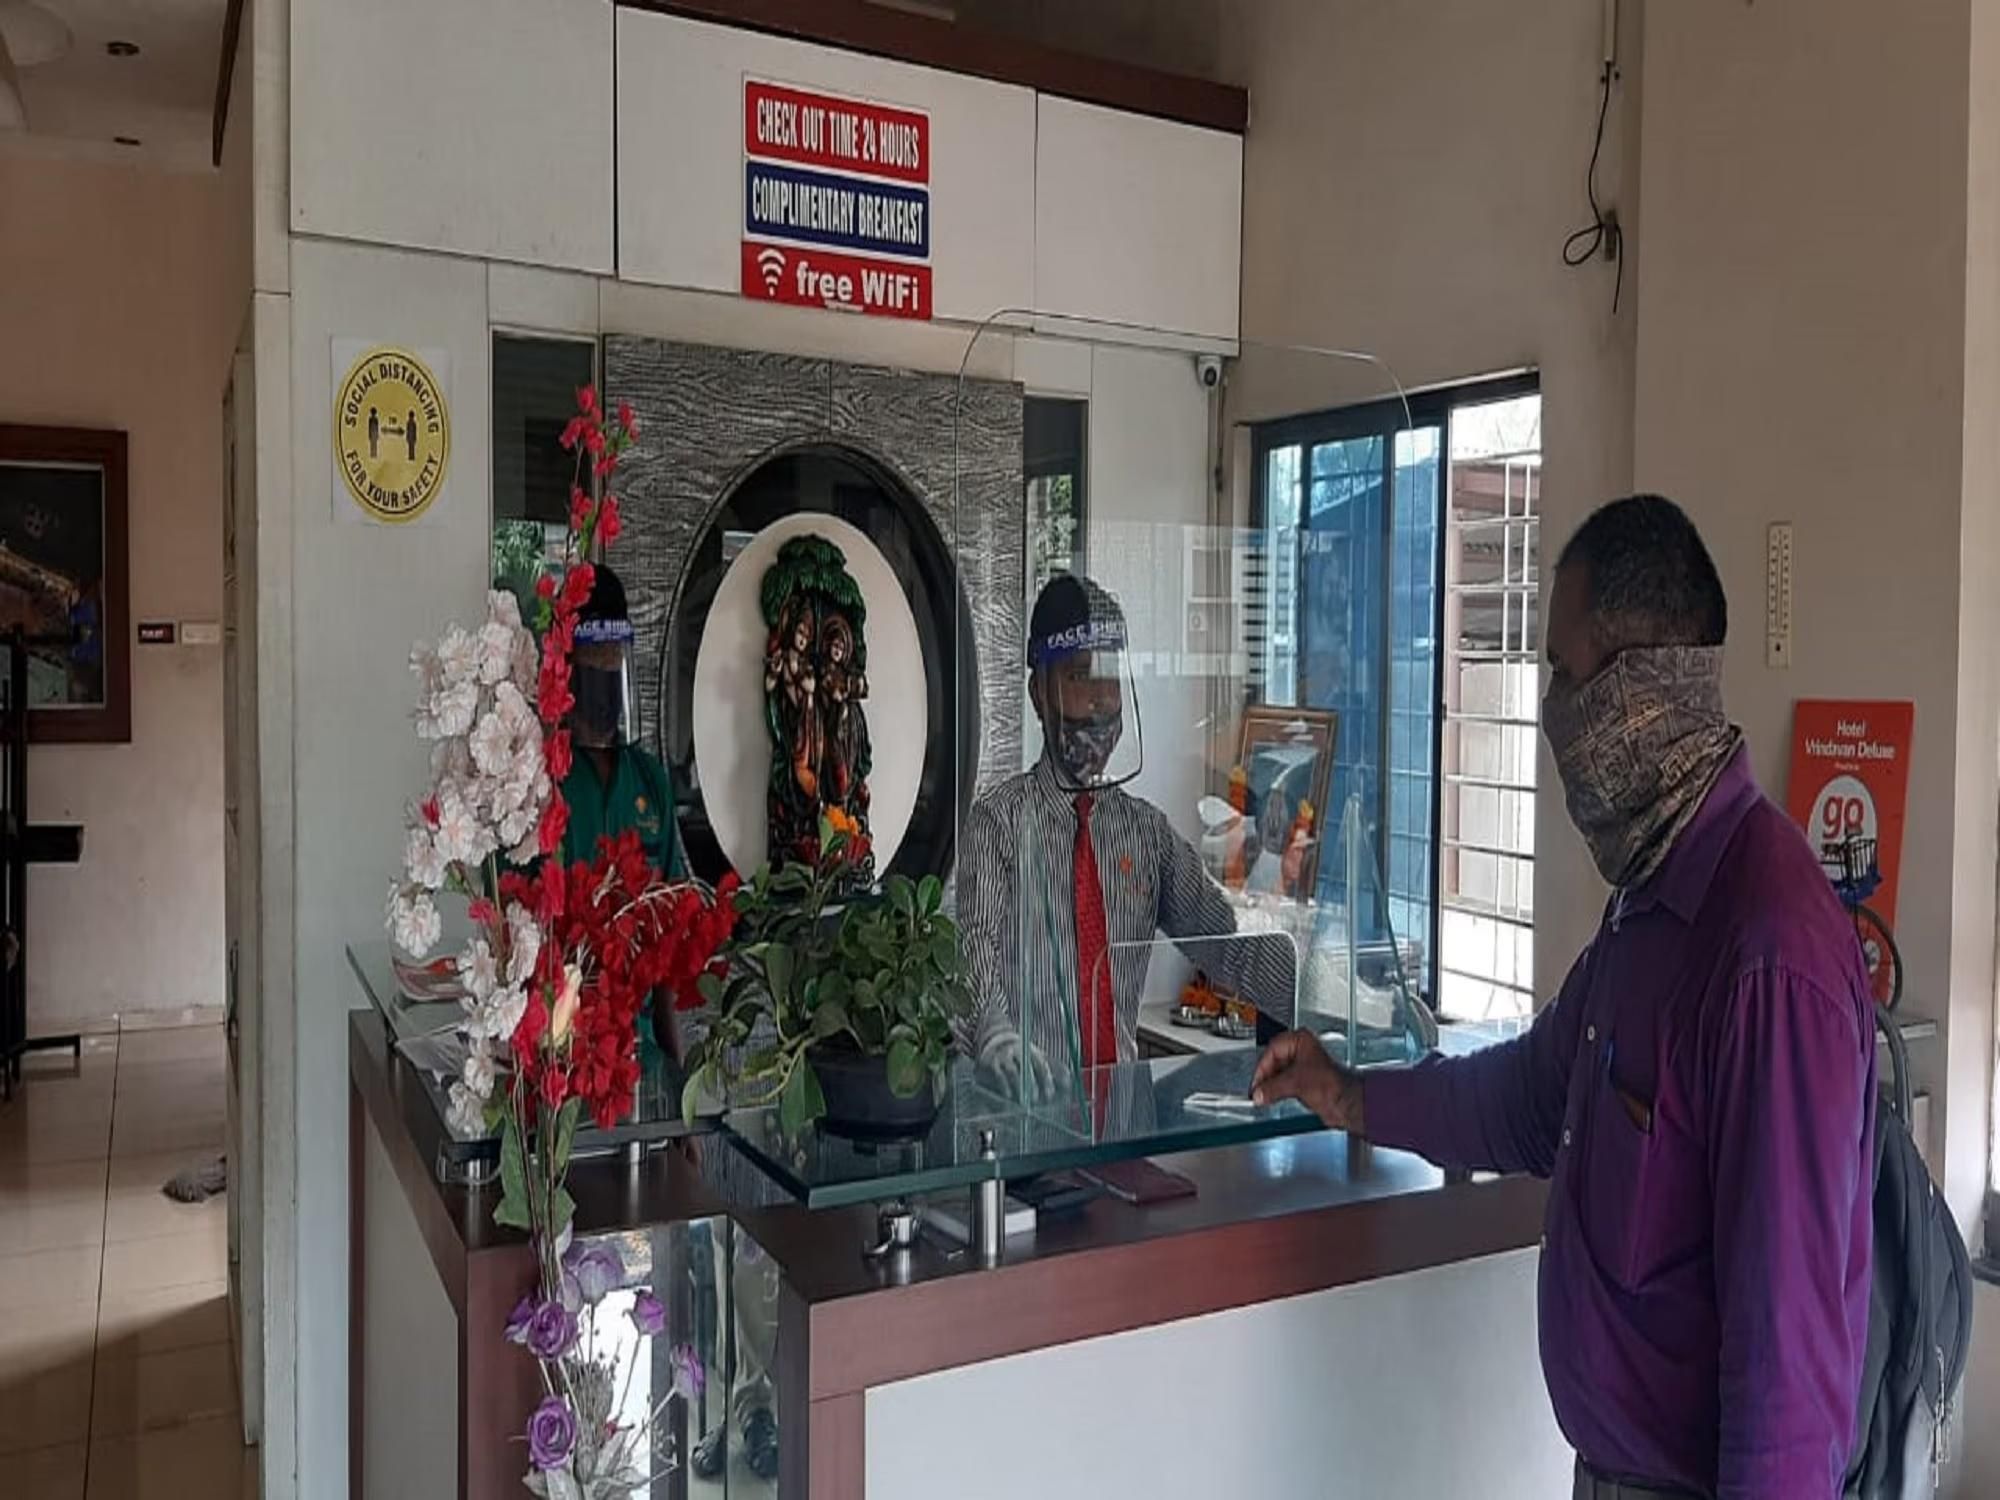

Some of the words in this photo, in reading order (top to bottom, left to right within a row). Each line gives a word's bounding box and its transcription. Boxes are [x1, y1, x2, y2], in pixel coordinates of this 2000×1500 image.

[757, 98, 798, 148] CHECK
[802, 106, 825, 153] OUT
[829, 112, 859, 160] TIME
[863, 117, 877, 162] 24
[880, 120, 920, 170] HOURS
[752, 175, 855, 235] COMPLIMENTARY
[858, 193, 923, 245] BREAKFAST
[796, 260, 853, 301] free
[861, 267, 919, 311] WiFi
[345, 370, 378, 428] SOCIAL
[379, 362, 439, 433] DISTANCING
[346, 449, 367, 488] FOR
[366, 481, 399, 509] YOUR
[402, 453, 438, 507] SAFETY
[1837, 720, 1865, 737] Hotel
[1857, 741, 1895, 760] Deluxe
